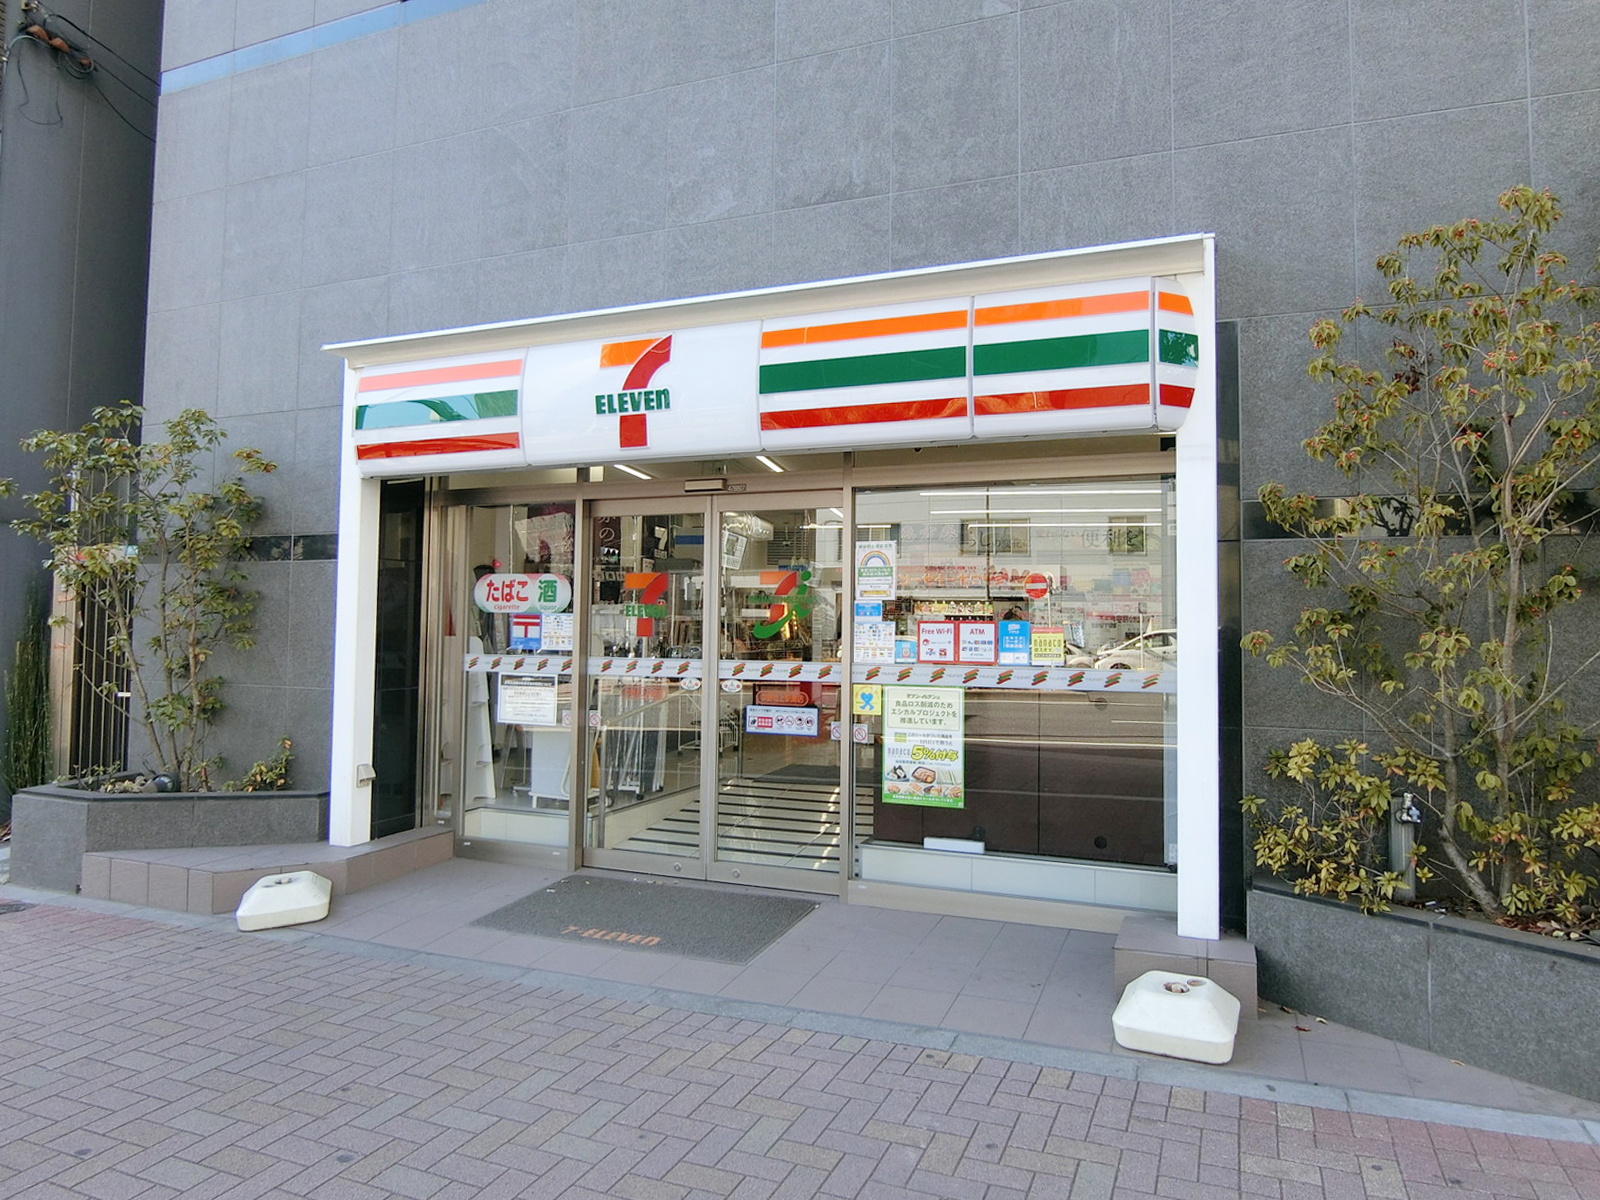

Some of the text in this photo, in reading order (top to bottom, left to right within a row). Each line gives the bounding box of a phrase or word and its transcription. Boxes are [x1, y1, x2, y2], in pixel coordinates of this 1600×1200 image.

[486, 579, 558, 602] たばこ 酒
[493, 603, 520, 611] cigarette
[895, 700, 953, 709] 食品ロス削減のため
[891, 708, 957, 718] エシカルプロジェクトを
